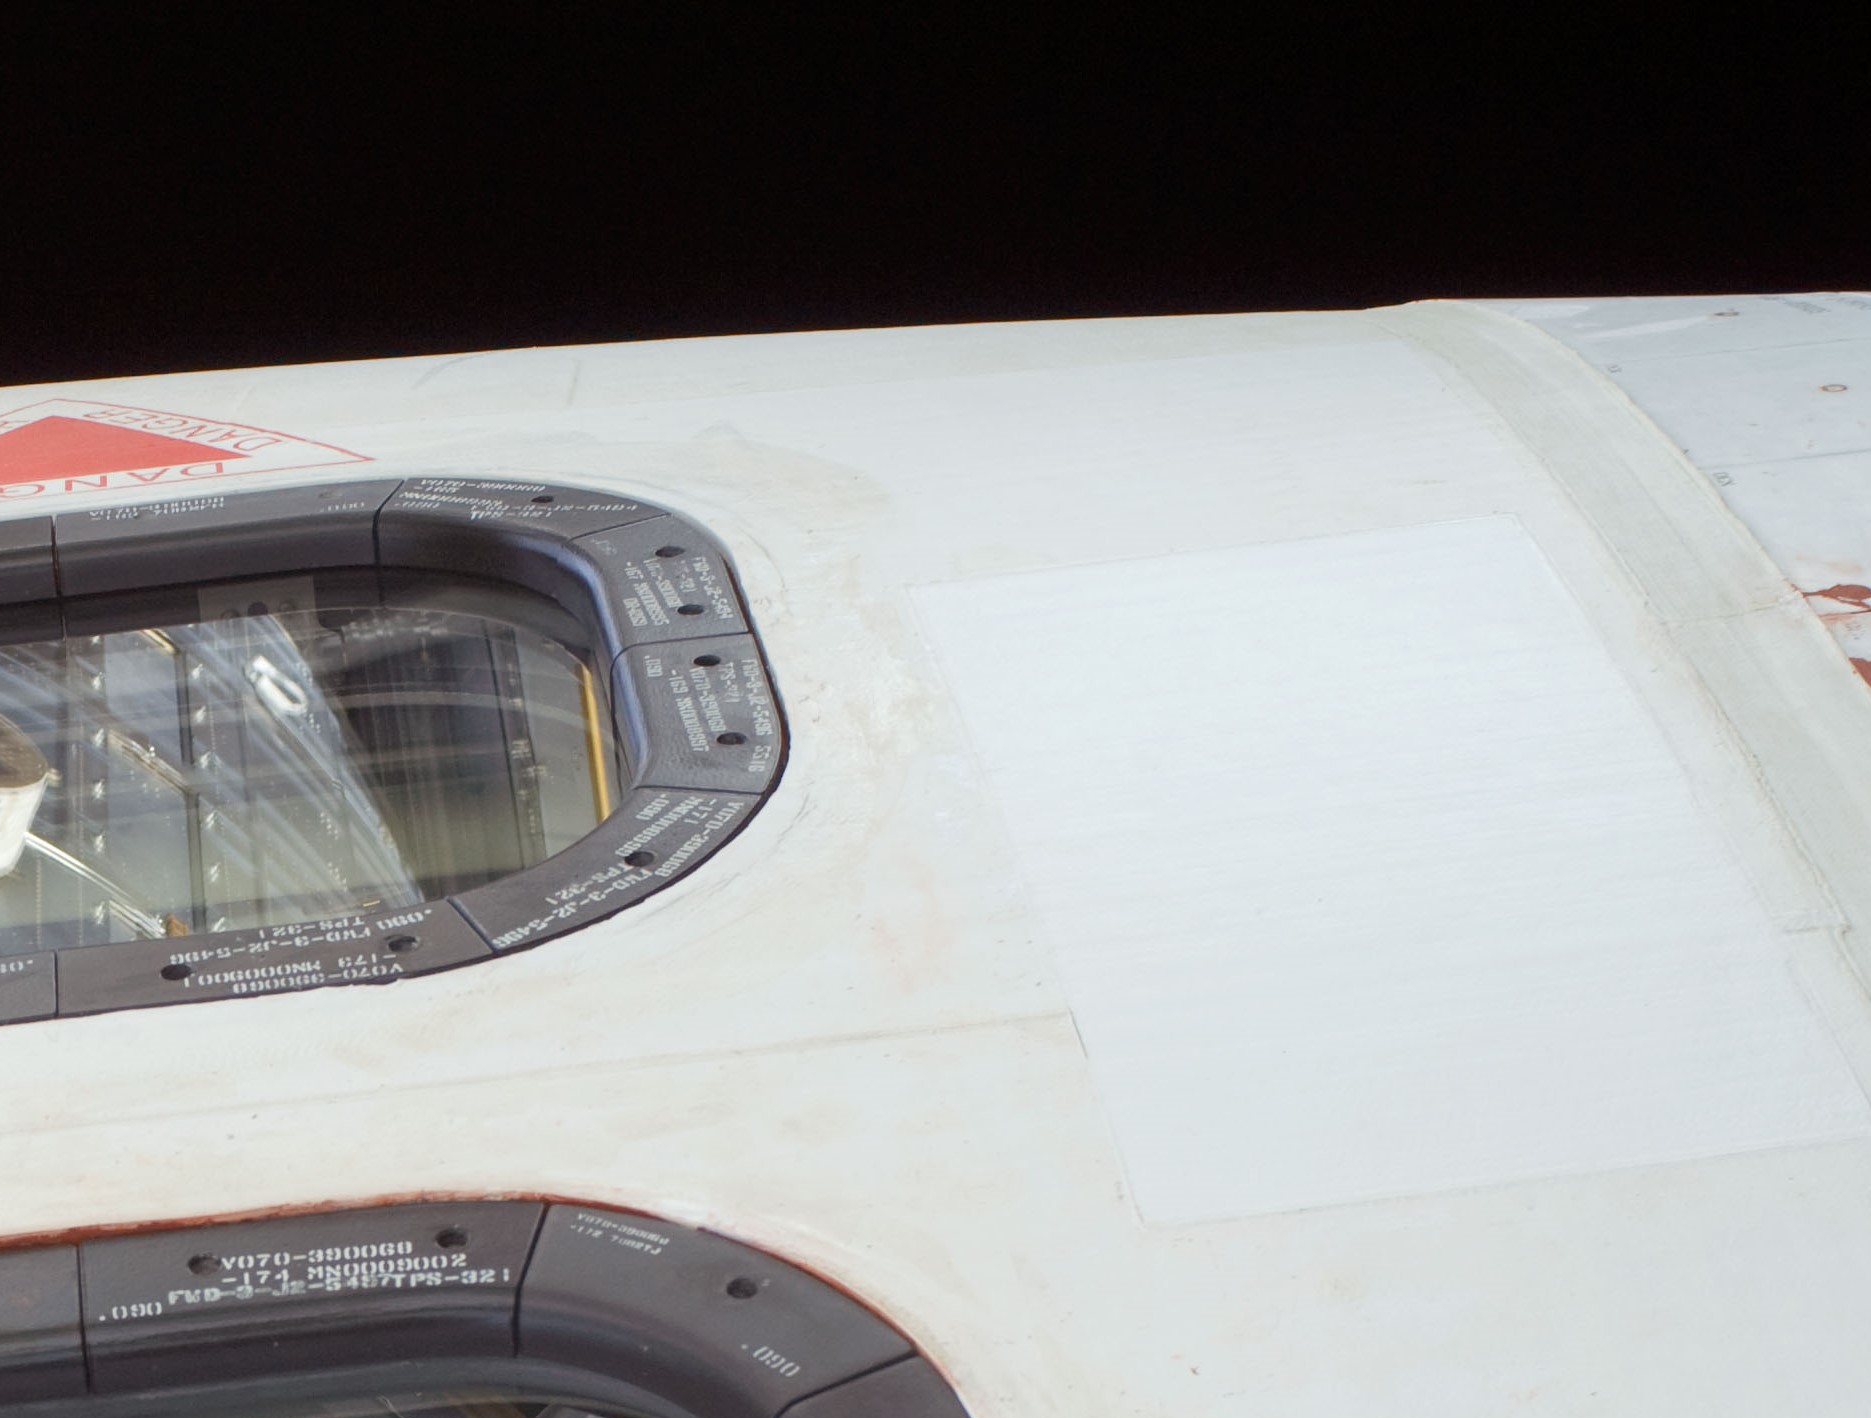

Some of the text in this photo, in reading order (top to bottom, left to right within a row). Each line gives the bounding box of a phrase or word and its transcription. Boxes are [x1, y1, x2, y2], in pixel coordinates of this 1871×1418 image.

[86, 409, 281, 451] DANGER
[221, 1240, 414, 1271] V070-390068
[222, 1252, 468, 1286] -174 MN0009002
[98, 1301, 164, 1322] .090
[739, 1342, 804, 1379] .090
